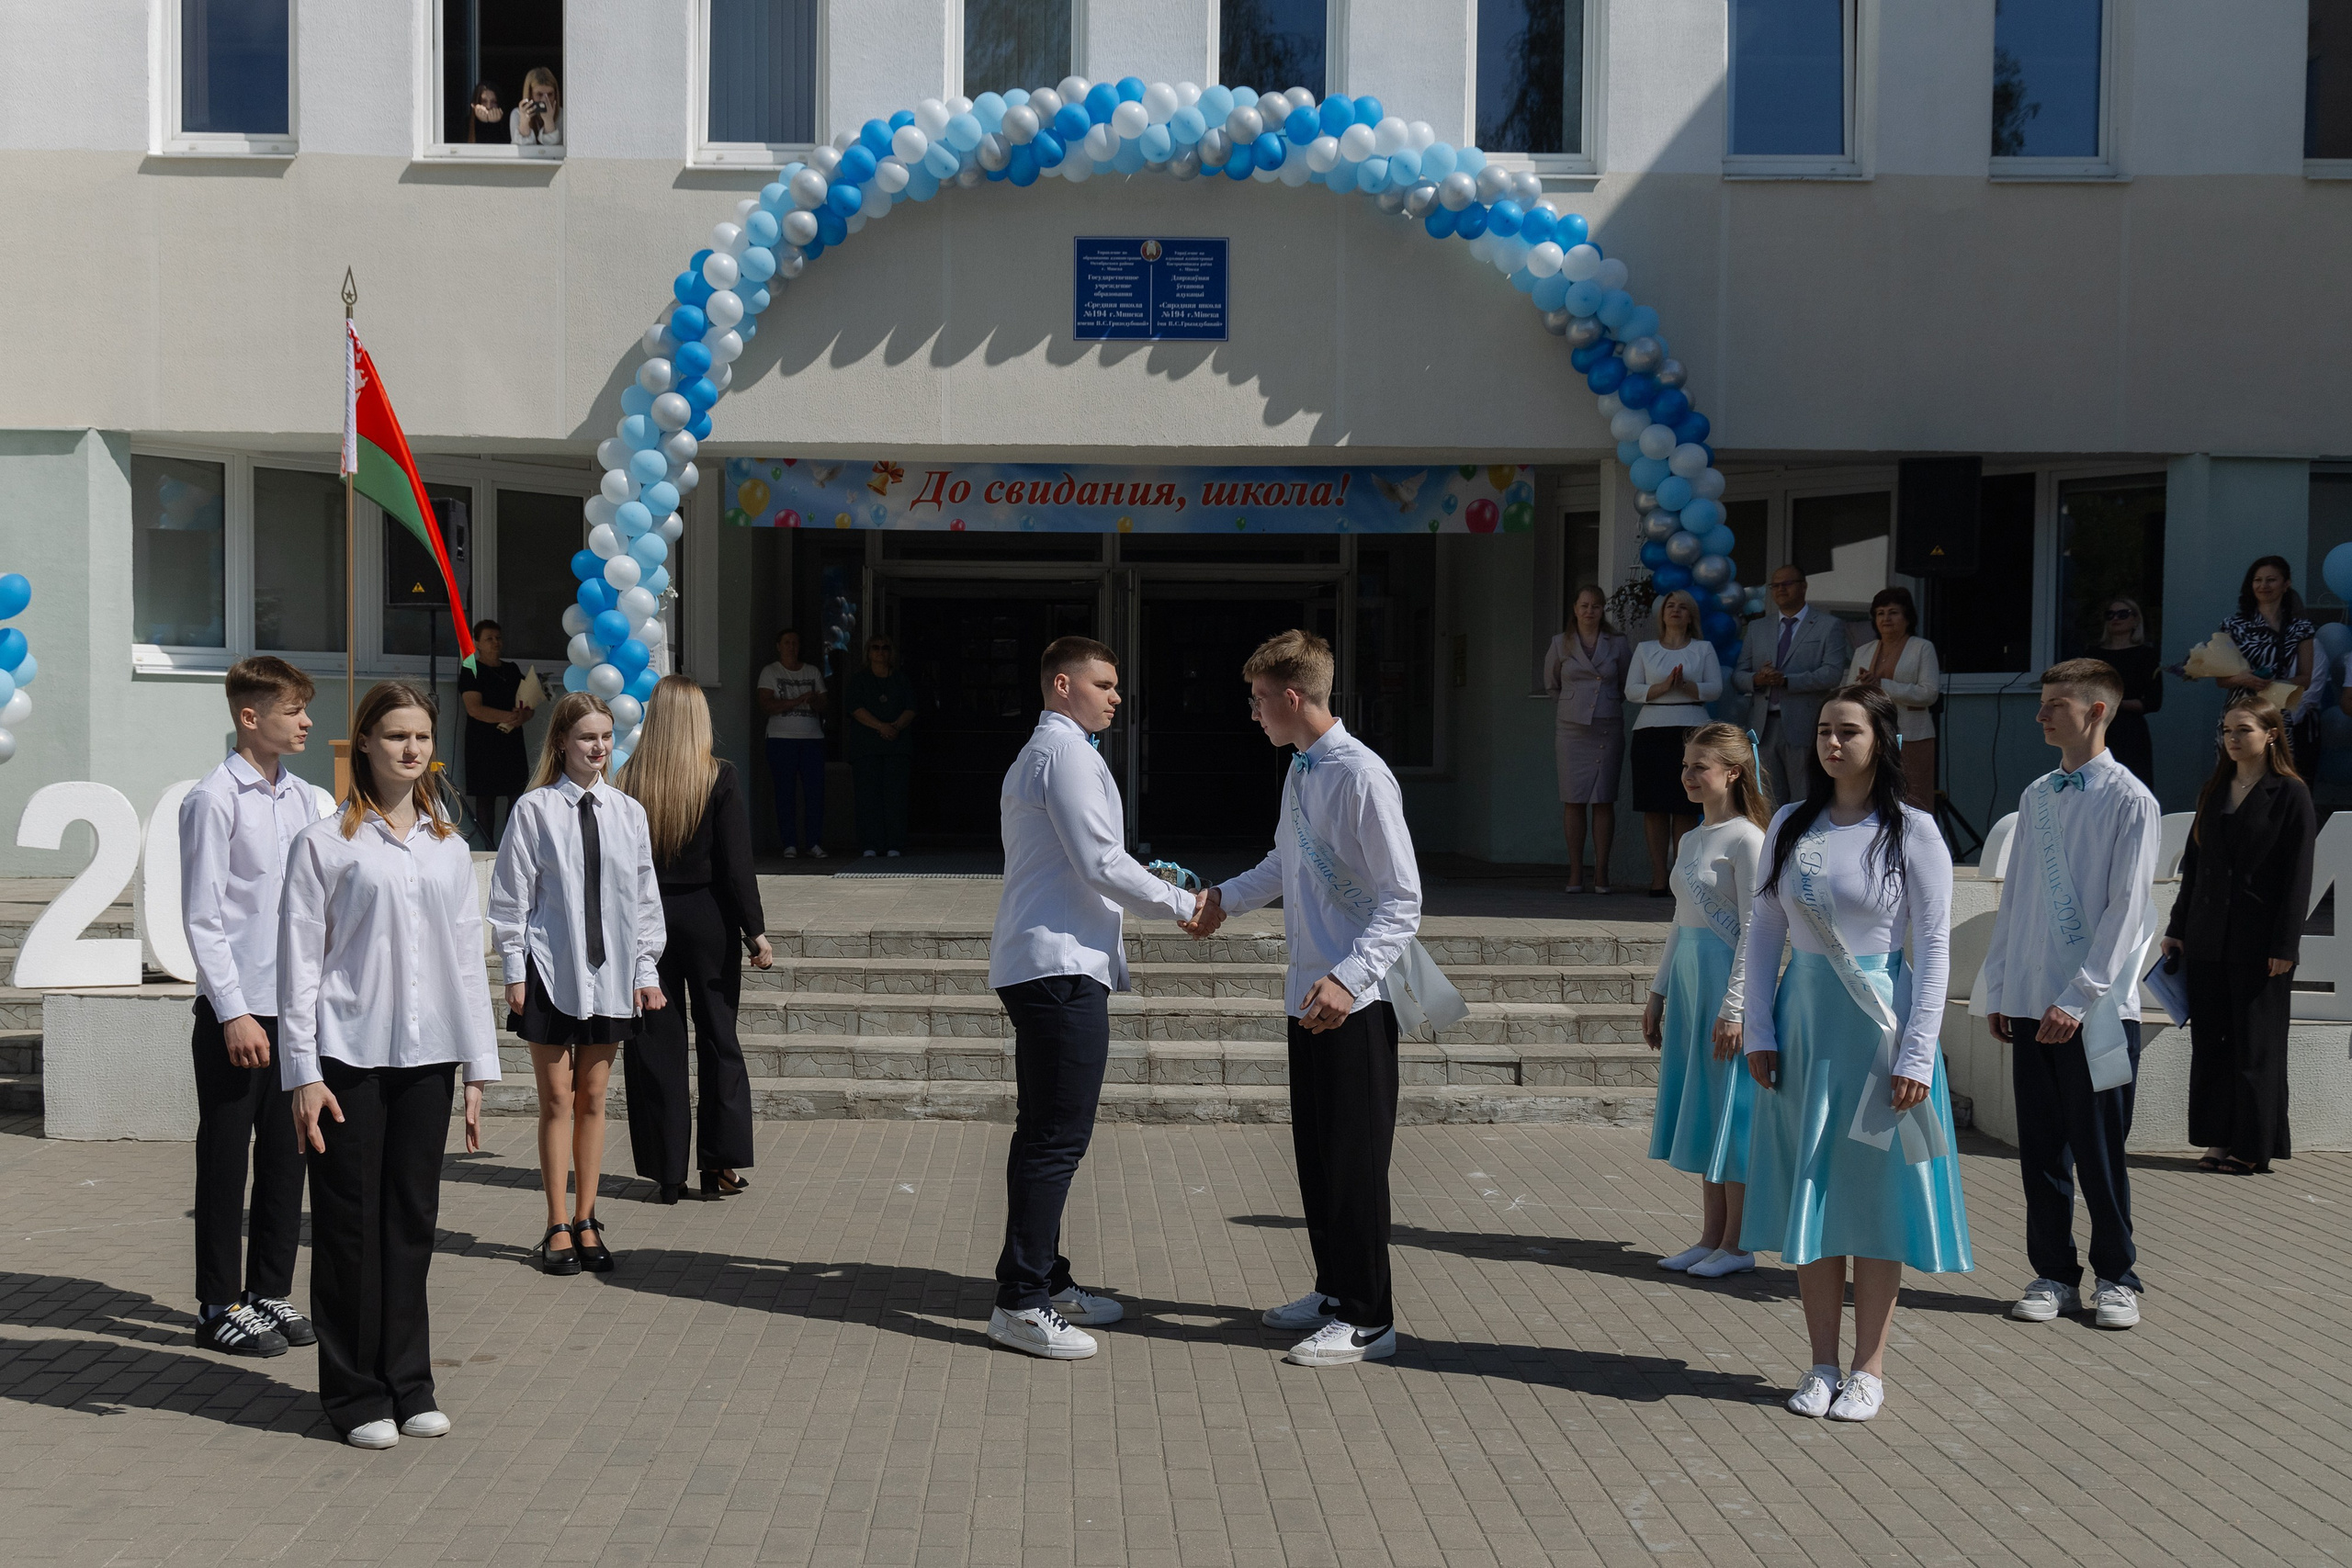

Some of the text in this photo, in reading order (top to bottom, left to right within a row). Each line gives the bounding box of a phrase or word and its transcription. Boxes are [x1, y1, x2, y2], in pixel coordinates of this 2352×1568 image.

[1088, 274, 1139, 282] Государственное
[1093, 290, 1133, 299] образования
[1083, 310, 1107, 318] №194
[1160, 310, 1185, 318] №194
[909, 470, 1351, 513] До свидания, школа!
[2053, 894, 2086, 946] 2024
